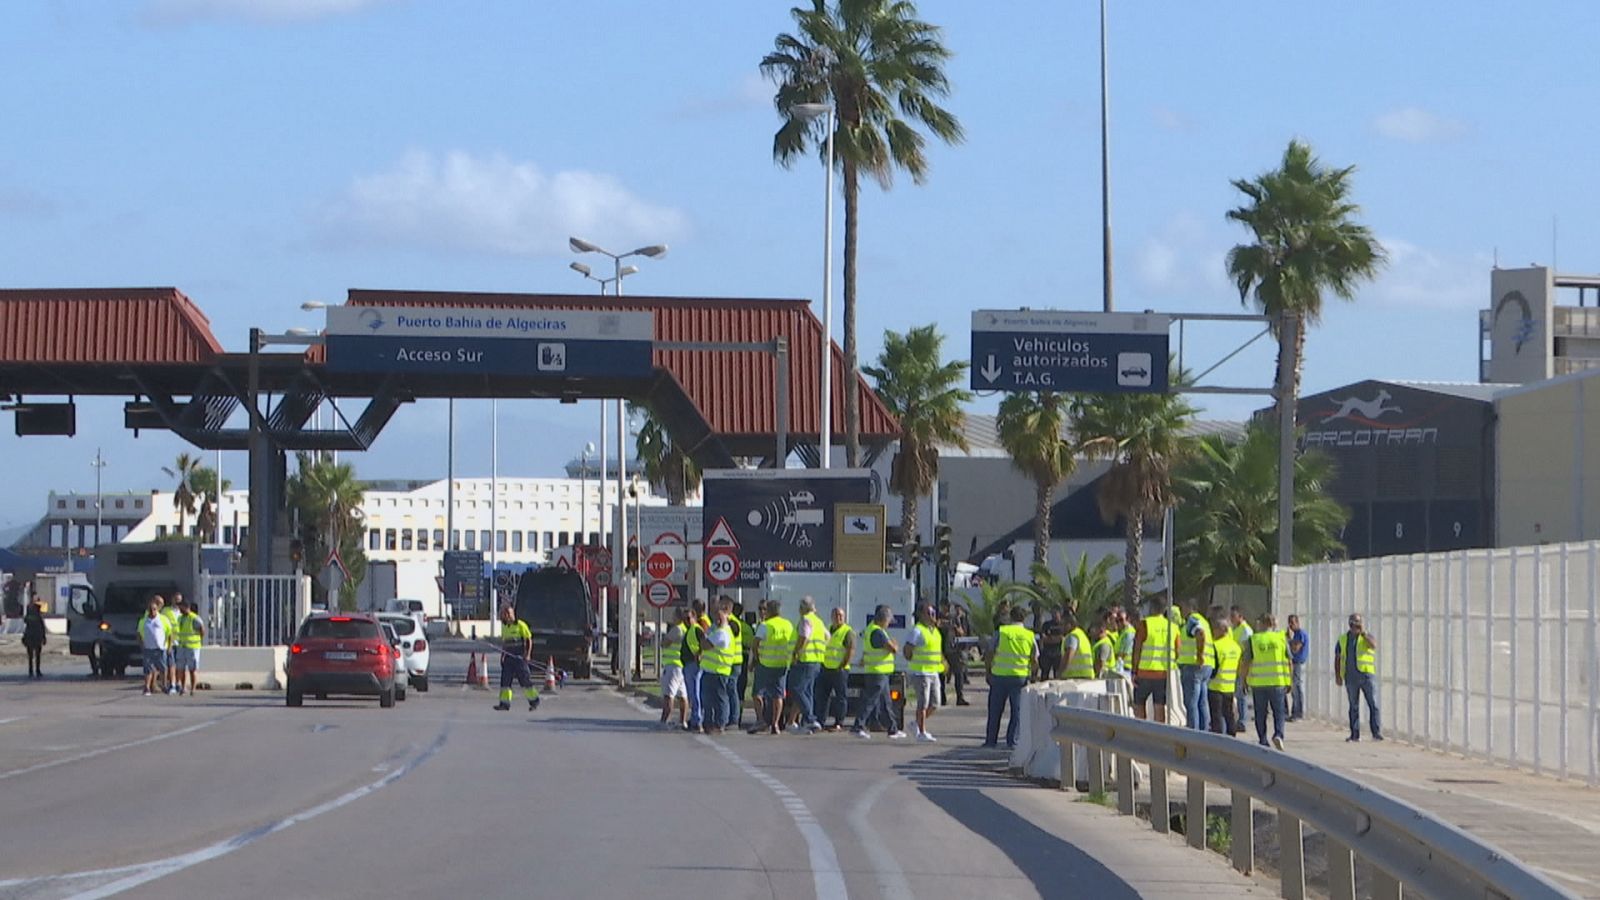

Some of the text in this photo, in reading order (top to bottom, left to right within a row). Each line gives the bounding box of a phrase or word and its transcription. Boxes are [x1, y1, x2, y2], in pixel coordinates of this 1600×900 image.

[397, 315, 442, 329] Puerto
[485, 316, 502, 330] de
[506, 317, 567, 332] Algeciras
[396, 347, 484, 363] Acceso Sur
[1013, 353, 1108, 367] autorizados
[1301, 427, 1438, 448] ARCOTRAN
[1396, 522, 1403, 538] 8
[1453, 521, 1462, 537] 9
[647, 561, 672, 571] STOP
[711, 560, 732, 574] 20
[811, 560, 826, 572] por
[740, 570, 760, 581] todo
